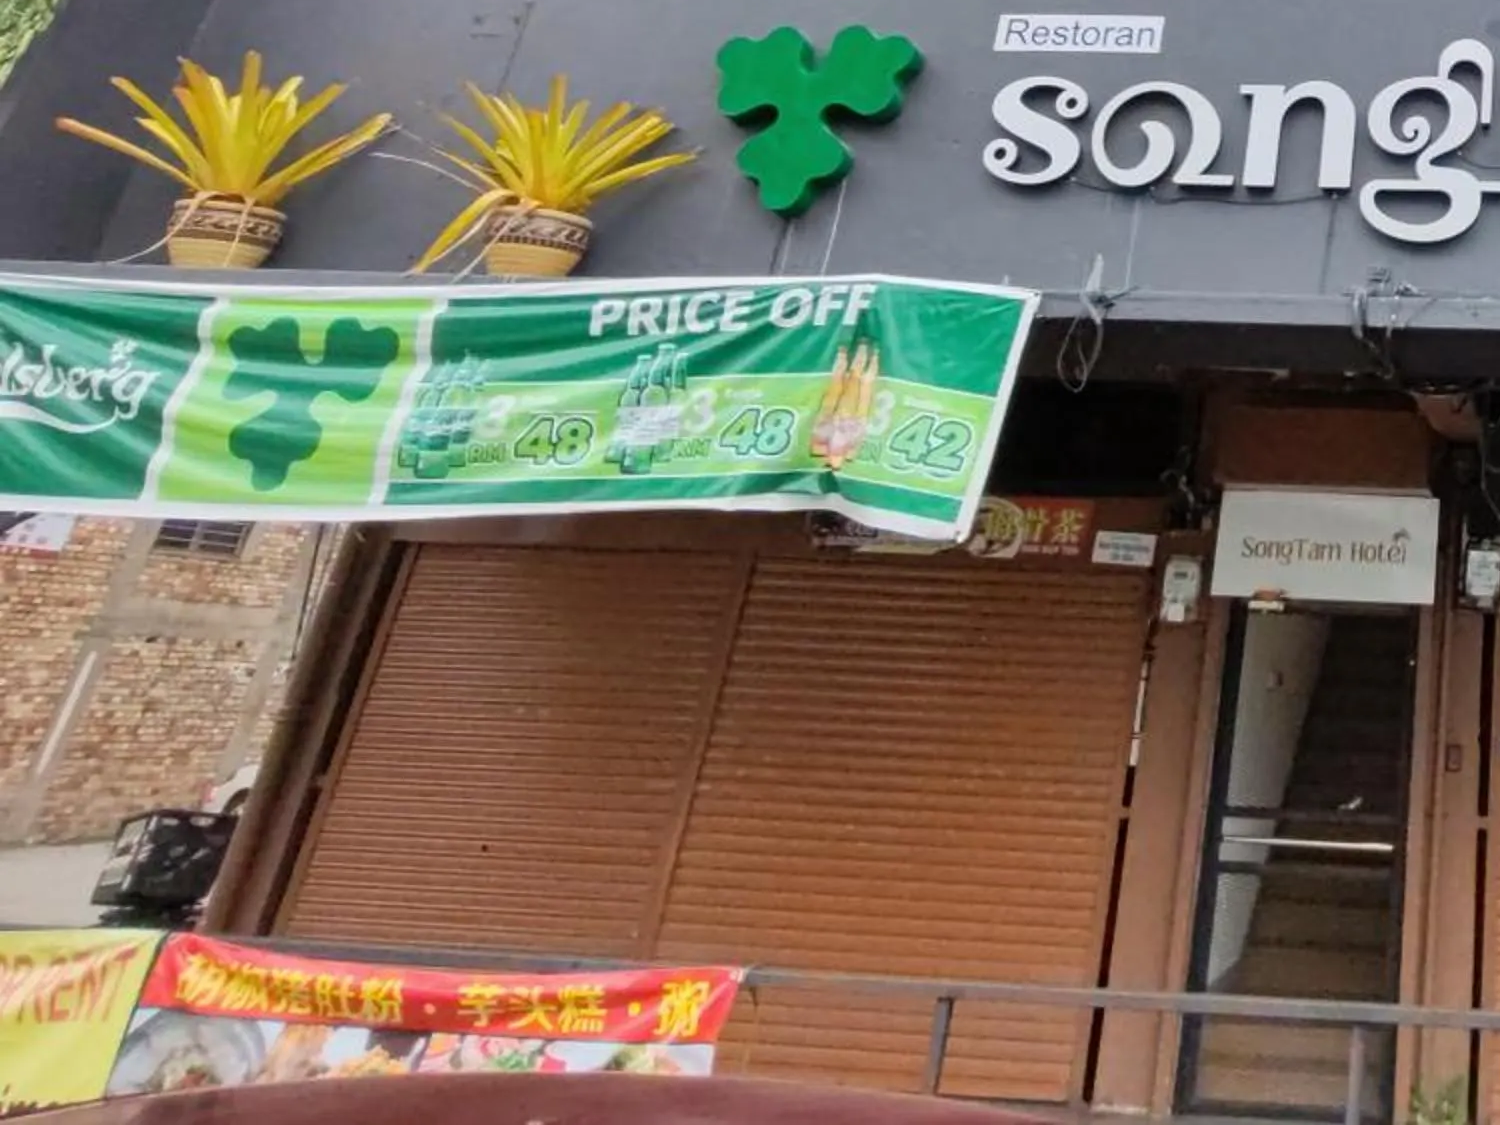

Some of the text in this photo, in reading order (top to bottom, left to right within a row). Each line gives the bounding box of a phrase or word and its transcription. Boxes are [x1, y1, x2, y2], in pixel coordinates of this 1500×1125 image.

[1005, 18, 1156, 47] Restoran
[589, 283, 879, 337] PRICE OFF
[0, 342, 161, 420] lsberg
[513, 415, 595, 466] 48
[719, 408, 796, 456] 48
[889, 414, 973, 472] 42
[1241, 536, 1341, 565] SongTam
